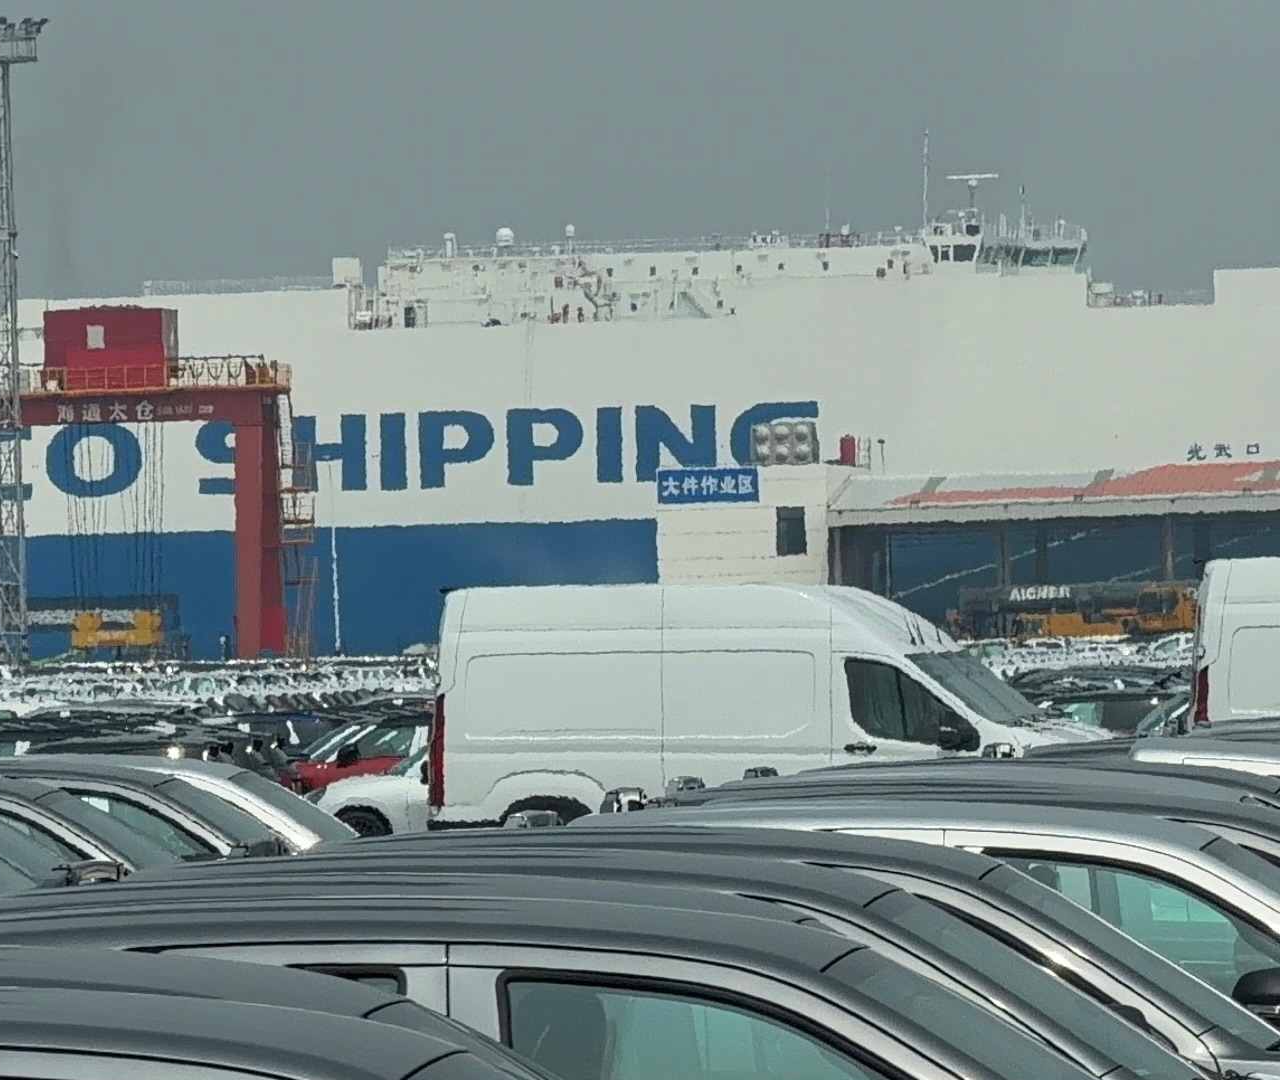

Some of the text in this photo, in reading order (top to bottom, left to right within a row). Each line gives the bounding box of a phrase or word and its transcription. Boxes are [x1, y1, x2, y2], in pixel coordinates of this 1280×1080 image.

[57, 400, 154, 423] 海通太仓
[662, 475, 755, 496] 大件作业区
